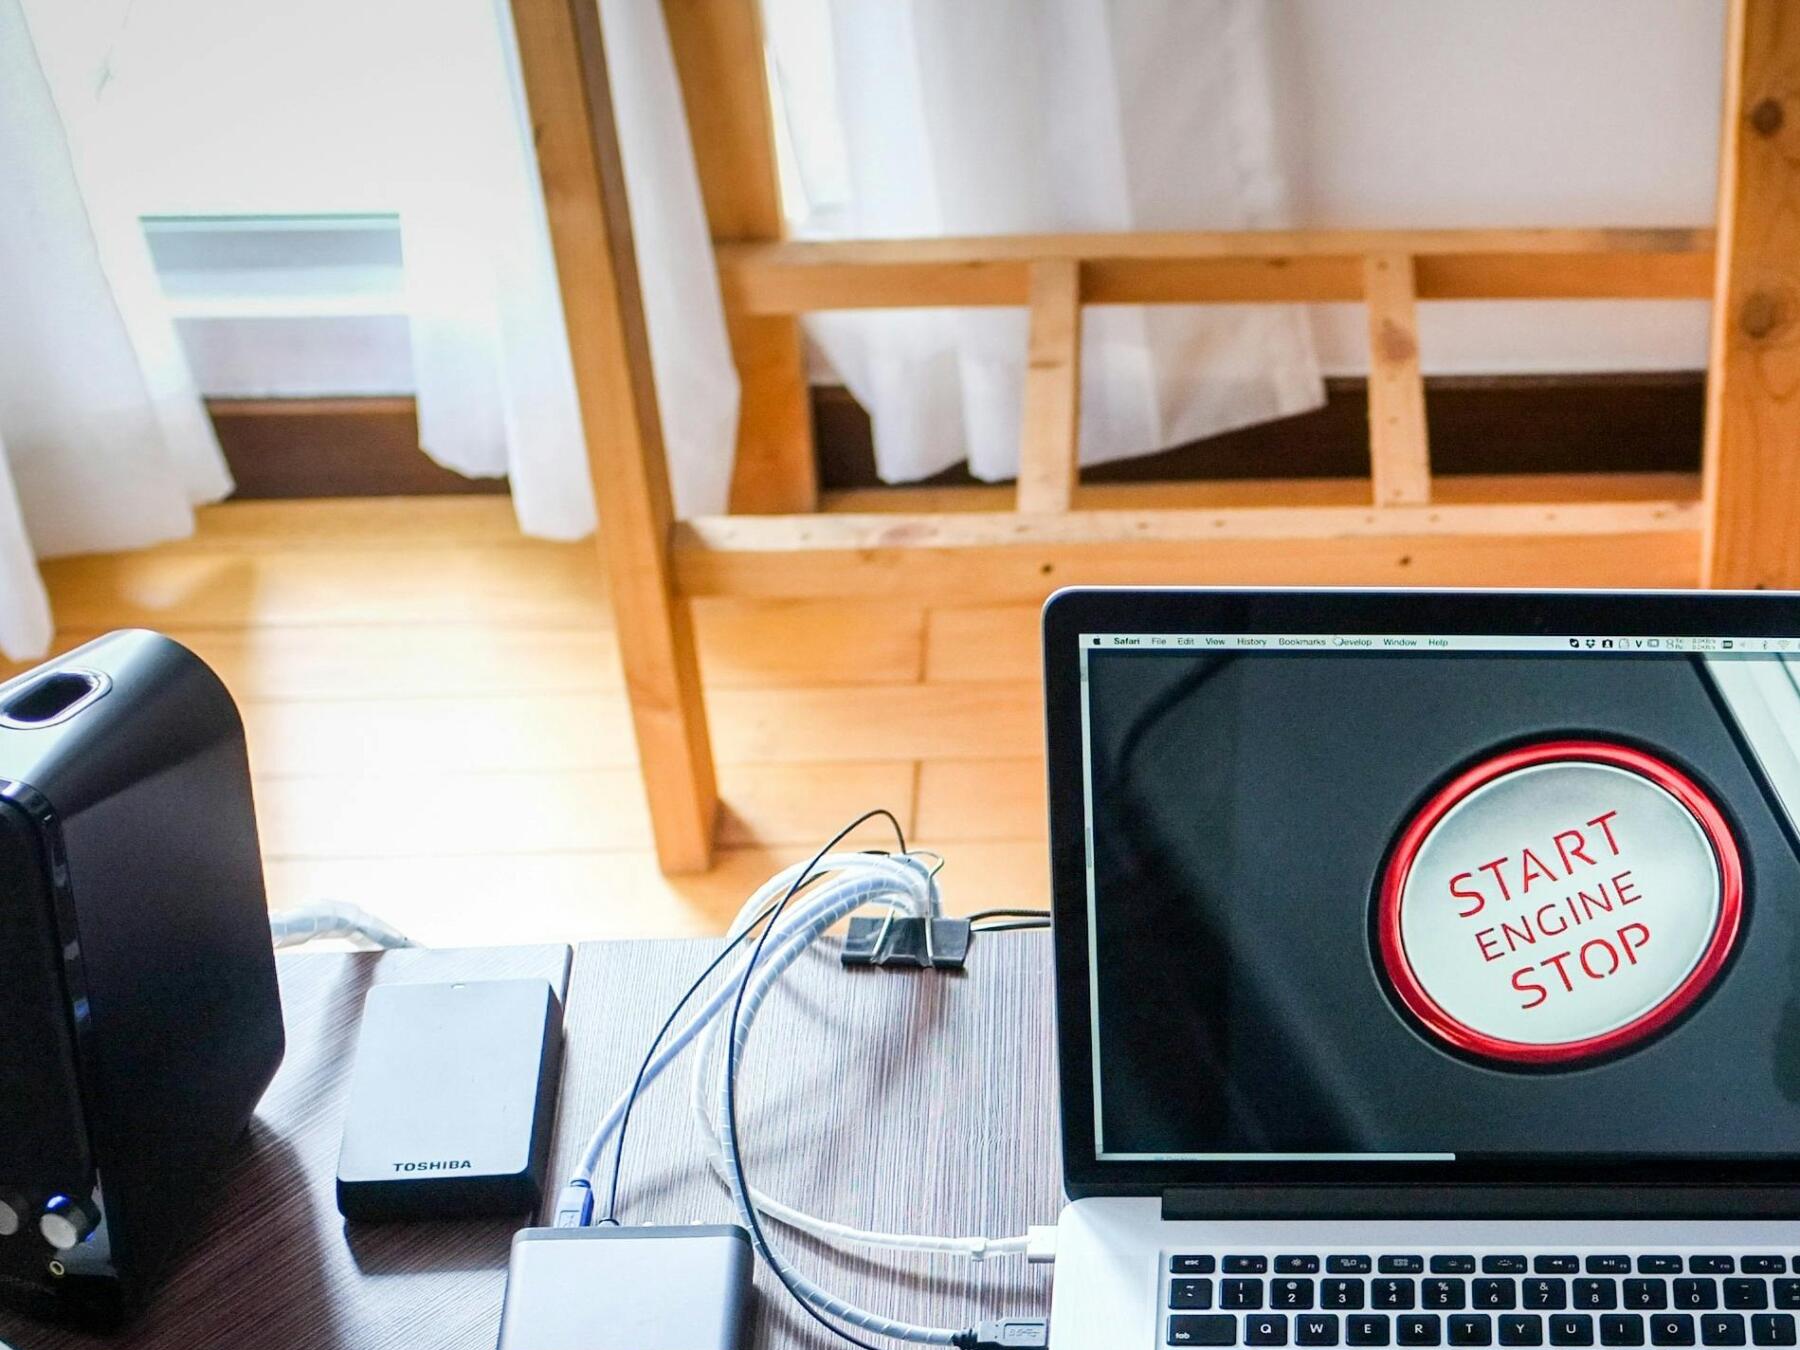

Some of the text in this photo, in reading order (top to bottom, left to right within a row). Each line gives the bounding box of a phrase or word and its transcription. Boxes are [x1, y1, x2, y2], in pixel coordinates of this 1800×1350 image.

[1237, 638, 1267, 646] History
[1279, 638, 1326, 646] Bookmarks
[1429, 639, 1448, 647] Help
[1449, 810, 1619, 918] START
[1474, 871, 1642, 962] ENGINE
[1511, 922, 1650, 1009] STOP
[393, 1161, 471, 1171] TOSHIBA
[1288, 1294, 1295, 1302] 2
[1339, 1294, 1346, 1302] 3
[1389, 1294, 1396, 1302] 4
[1440, 1294, 1447, 1302] 5
[1491, 1294, 1498, 1302] 6
[1541, 1294, 1548, 1302] 7
[1592, 1294, 1599, 1302] 8
[1642, 1294, 1649, 1302] 9
[1261, 1324, 1271, 1333] Q
[1310, 1324, 1323, 1333] W
[1365, 1324, 1371, 1333] E
[1415, 1324, 1422, 1333] R
[1466, 1324, 1473, 1333] T
[1516, 1324, 1524, 1333] Y
[1566, 1324, 1576, 1333] U
[1719, 1324, 1727, 1333] P
